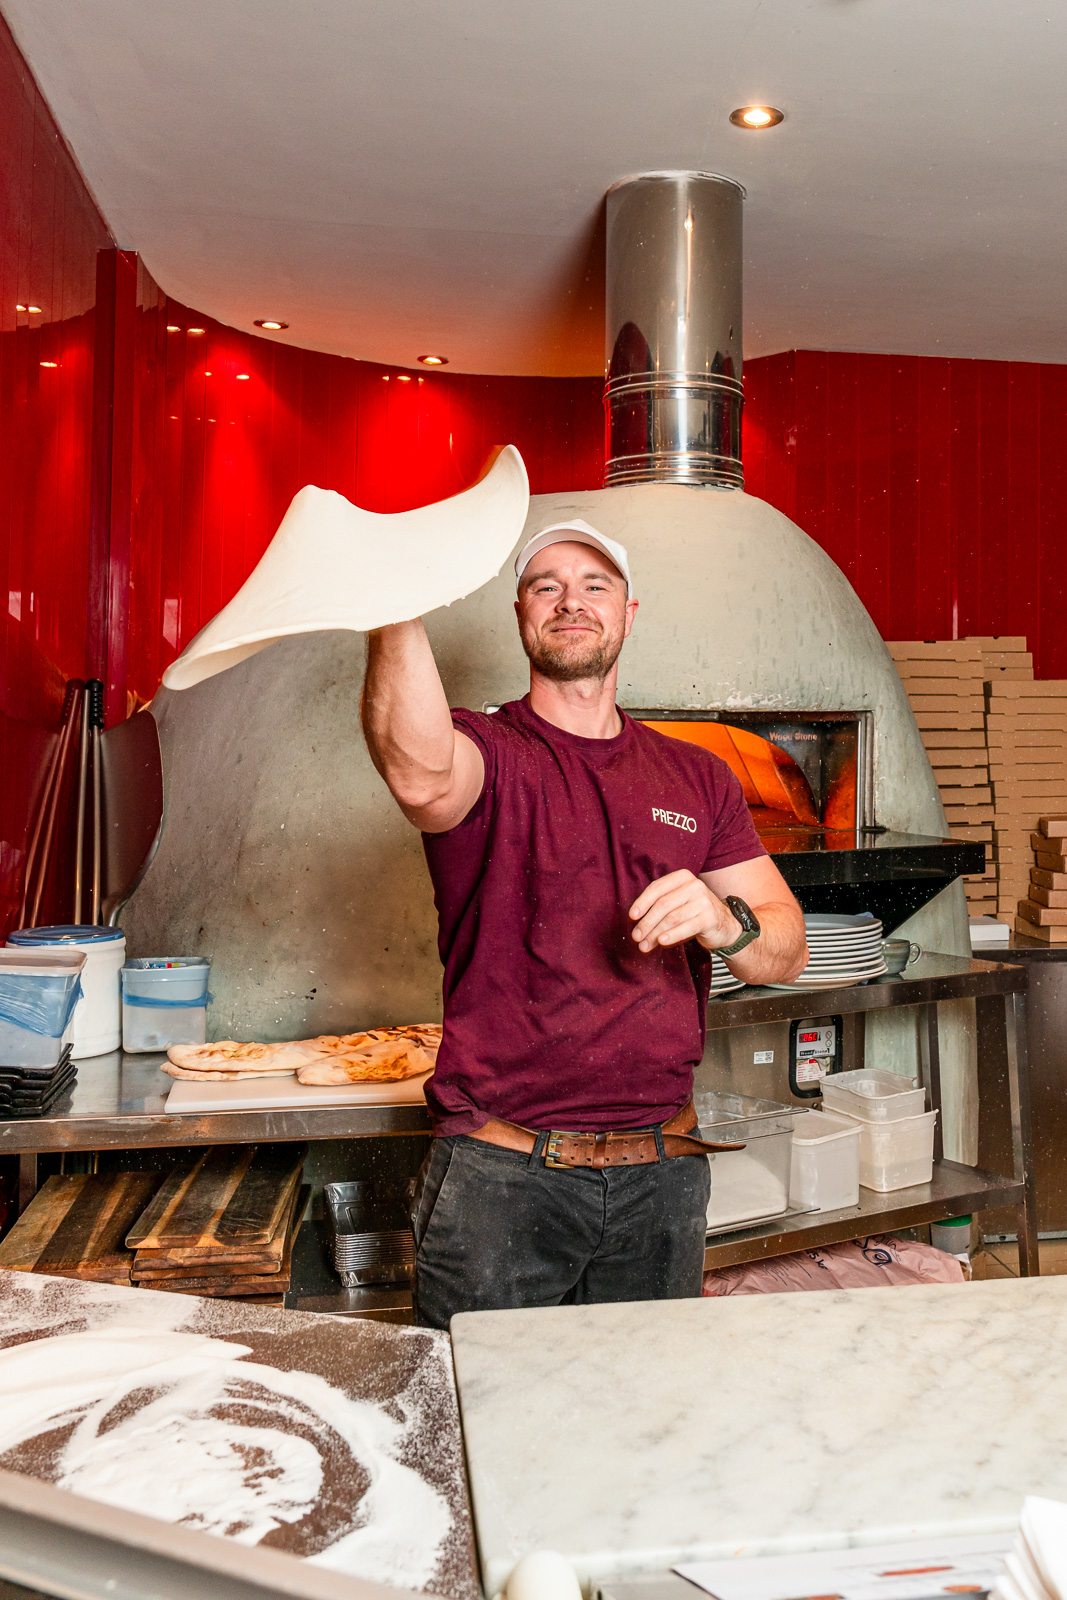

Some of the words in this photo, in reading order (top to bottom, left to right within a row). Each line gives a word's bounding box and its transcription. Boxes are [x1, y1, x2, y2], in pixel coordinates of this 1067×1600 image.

[769, 732, 792, 741] Wood
[795, 732, 817, 741] Stone
[652, 808, 697, 833] PREZZO
